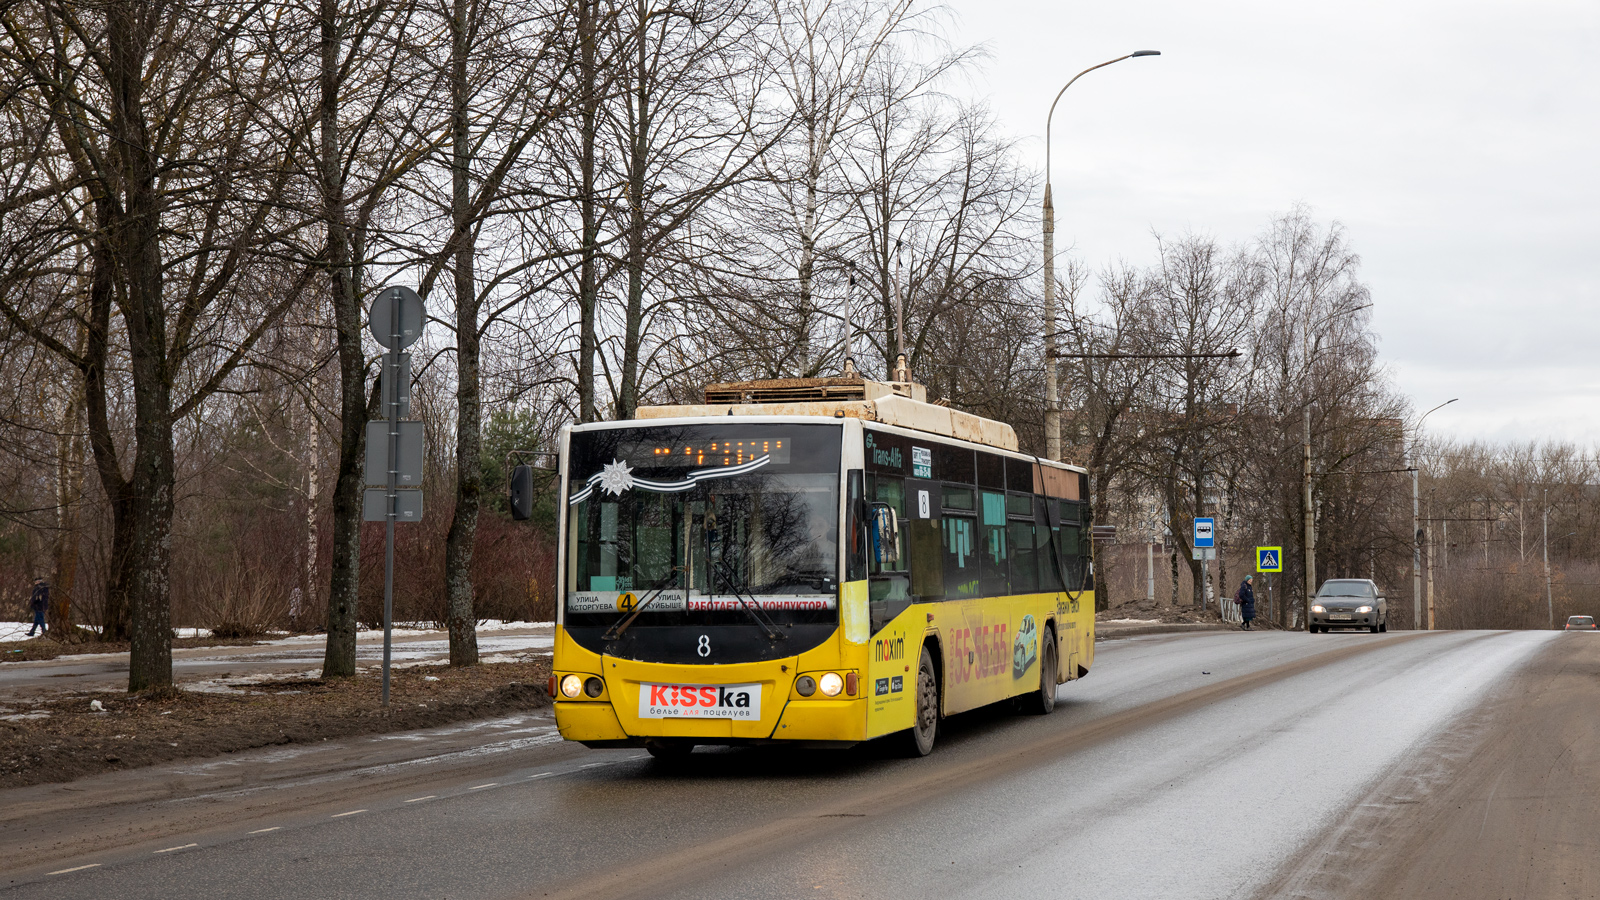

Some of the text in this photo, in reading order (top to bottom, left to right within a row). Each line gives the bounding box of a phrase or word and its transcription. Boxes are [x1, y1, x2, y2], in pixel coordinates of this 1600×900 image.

[872, 443, 902, 468] Trans-Alfa
[921, 494, 927, 514] 8
[621, 594, 633, 612] 4
[688, 601, 828, 611] РАБОТАЕТ БЕЗ КОНДУКТОРА
[697, 634, 711, 657] 8
[703, 709, 750, 717] поцелуев
